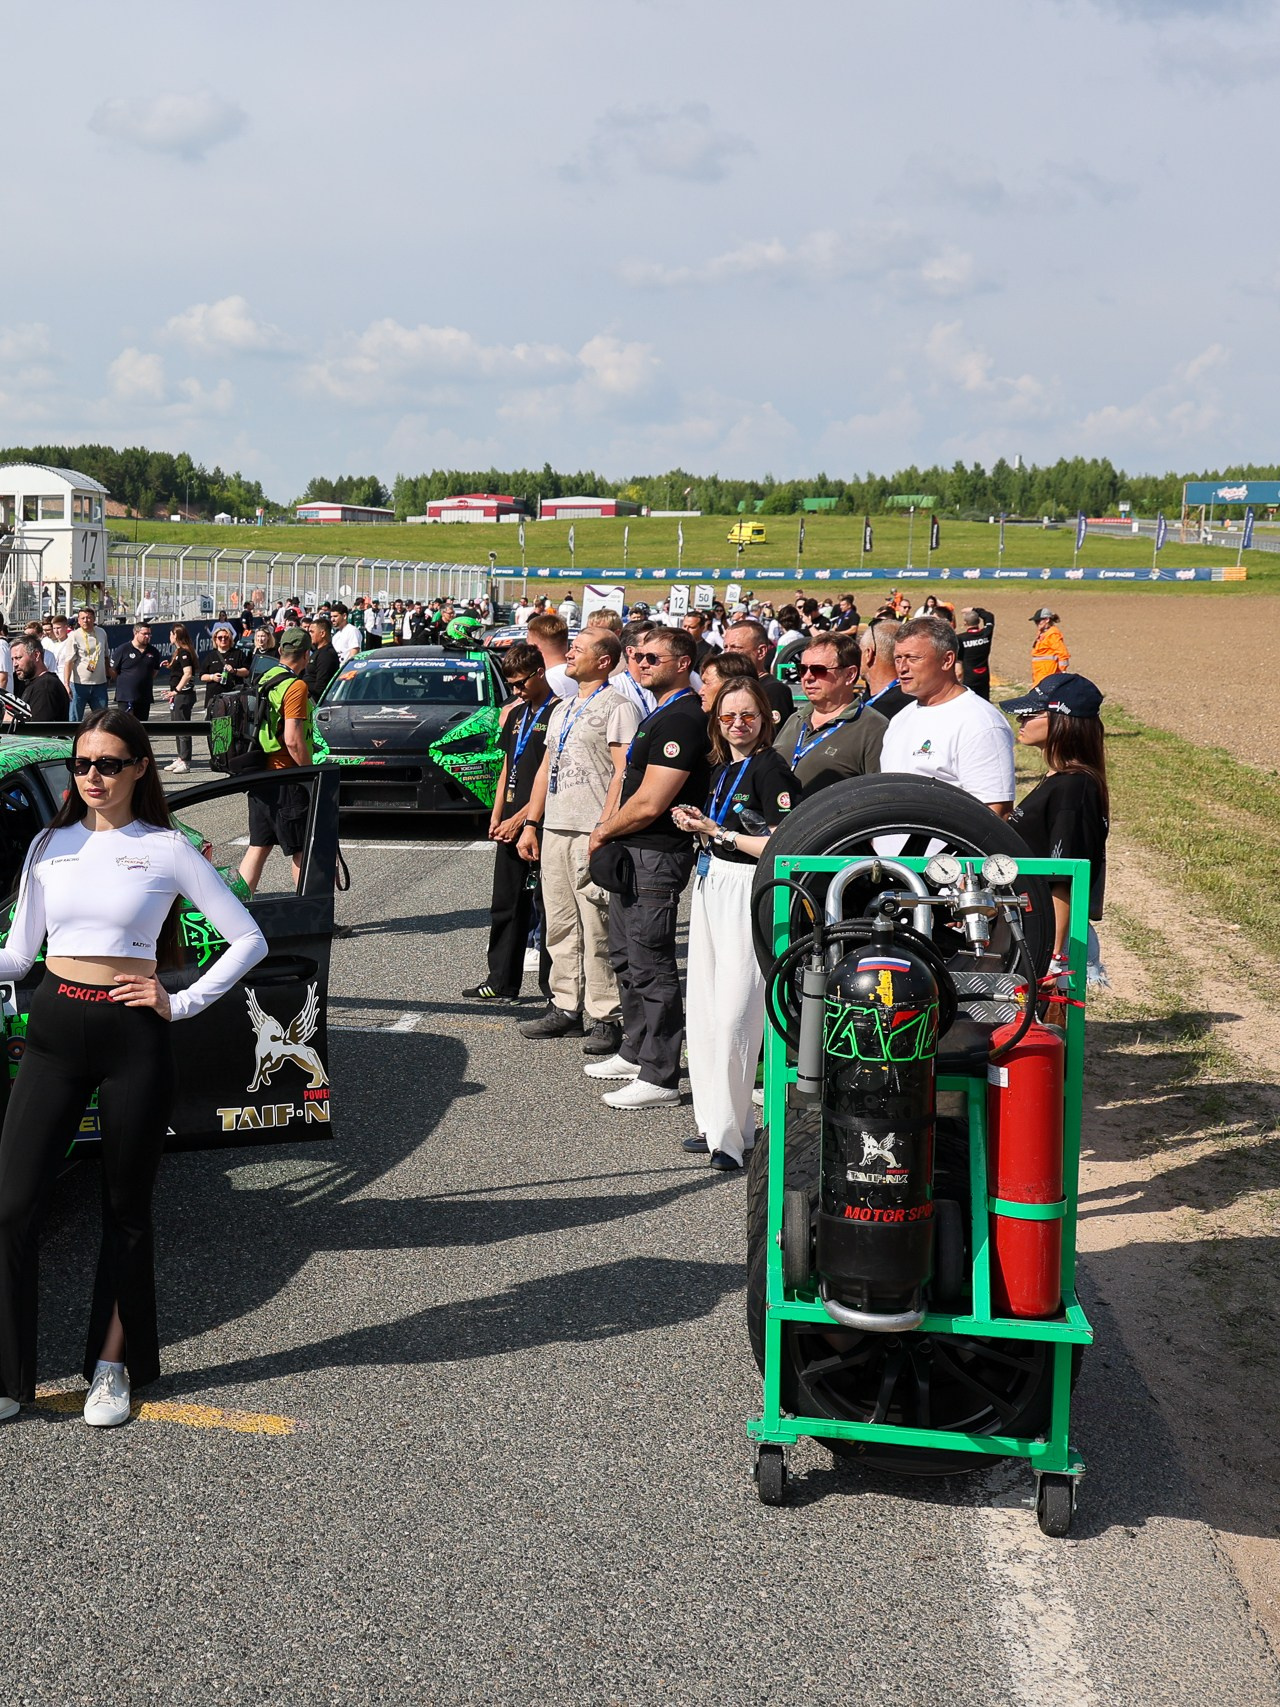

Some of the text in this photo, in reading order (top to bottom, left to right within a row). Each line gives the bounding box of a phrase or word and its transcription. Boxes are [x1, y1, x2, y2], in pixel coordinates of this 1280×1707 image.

[81, 530, 98, 563] 17
[674, 596, 685, 609] 12
[698, 593, 710, 603] 50
[462, 773, 492, 782] RAVENOL
[844, 1204, 904, 1223] MOTOR
